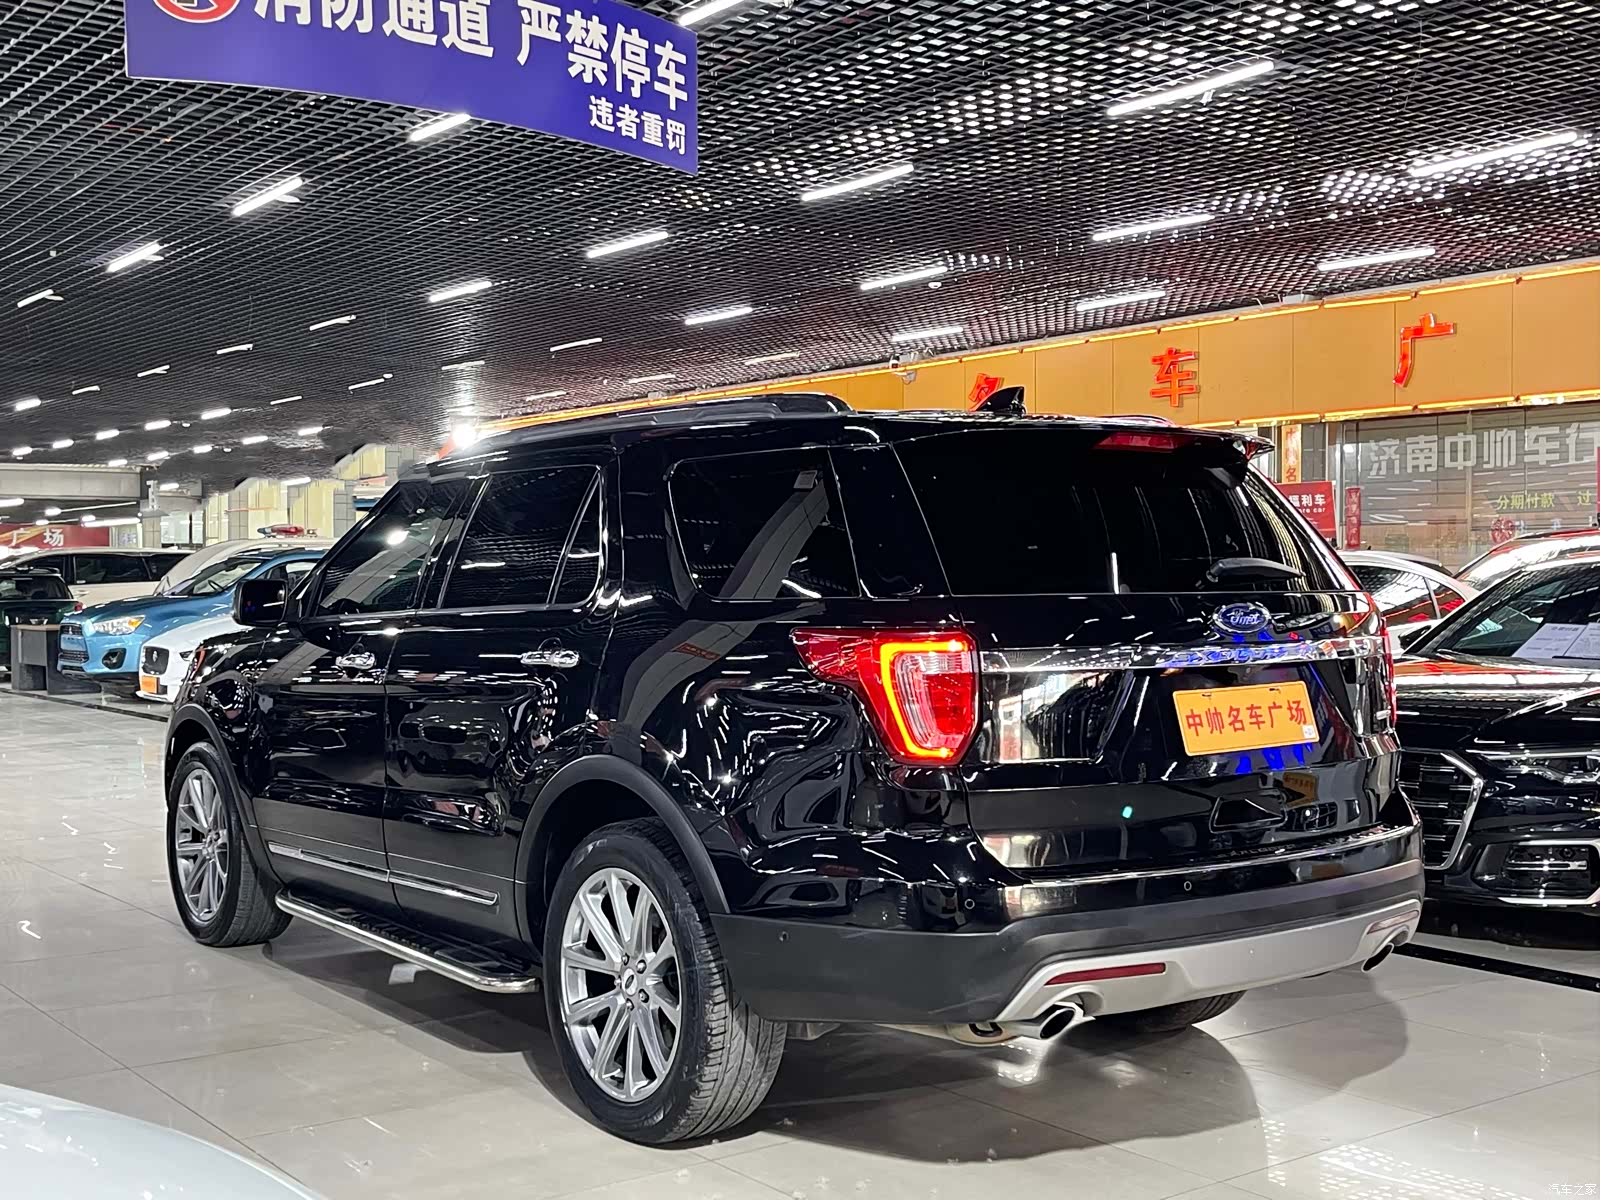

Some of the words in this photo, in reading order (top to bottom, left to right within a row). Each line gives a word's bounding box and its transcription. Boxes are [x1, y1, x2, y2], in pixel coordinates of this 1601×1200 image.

[516, 2, 690, 112] 严禁停车
[588, 94, 687, 157] 违者重罚
[1368, 422, 1601, 476] 济南中帅车行
[1497, 492, 1555, 510] 分期付款
[1226, 608, 1262, 626] Ford
[1185, 699, 1307, 737] 中帅名车广场
